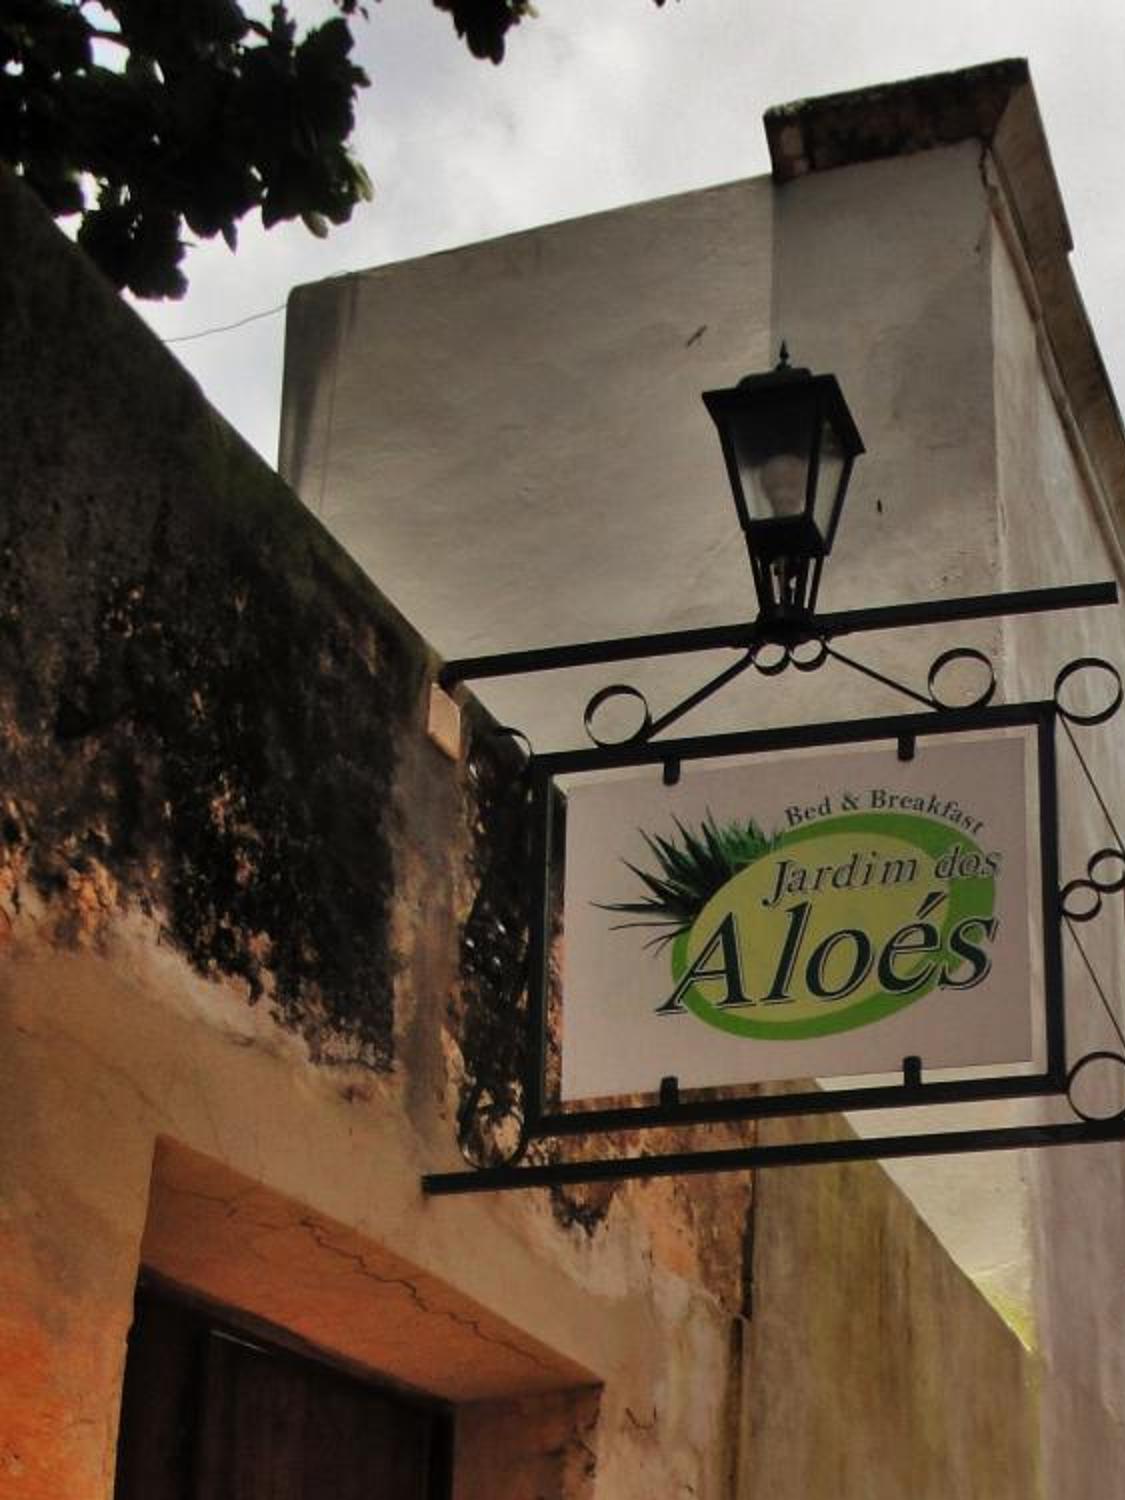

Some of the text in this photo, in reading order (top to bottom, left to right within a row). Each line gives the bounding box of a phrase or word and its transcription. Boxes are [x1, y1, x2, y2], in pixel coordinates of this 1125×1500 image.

[785, 788, 985, 835] Bed & Breakfast
[762, 844, 1002, 908] Jardim dos
[655, 890, 1001, 1017] Aloés
